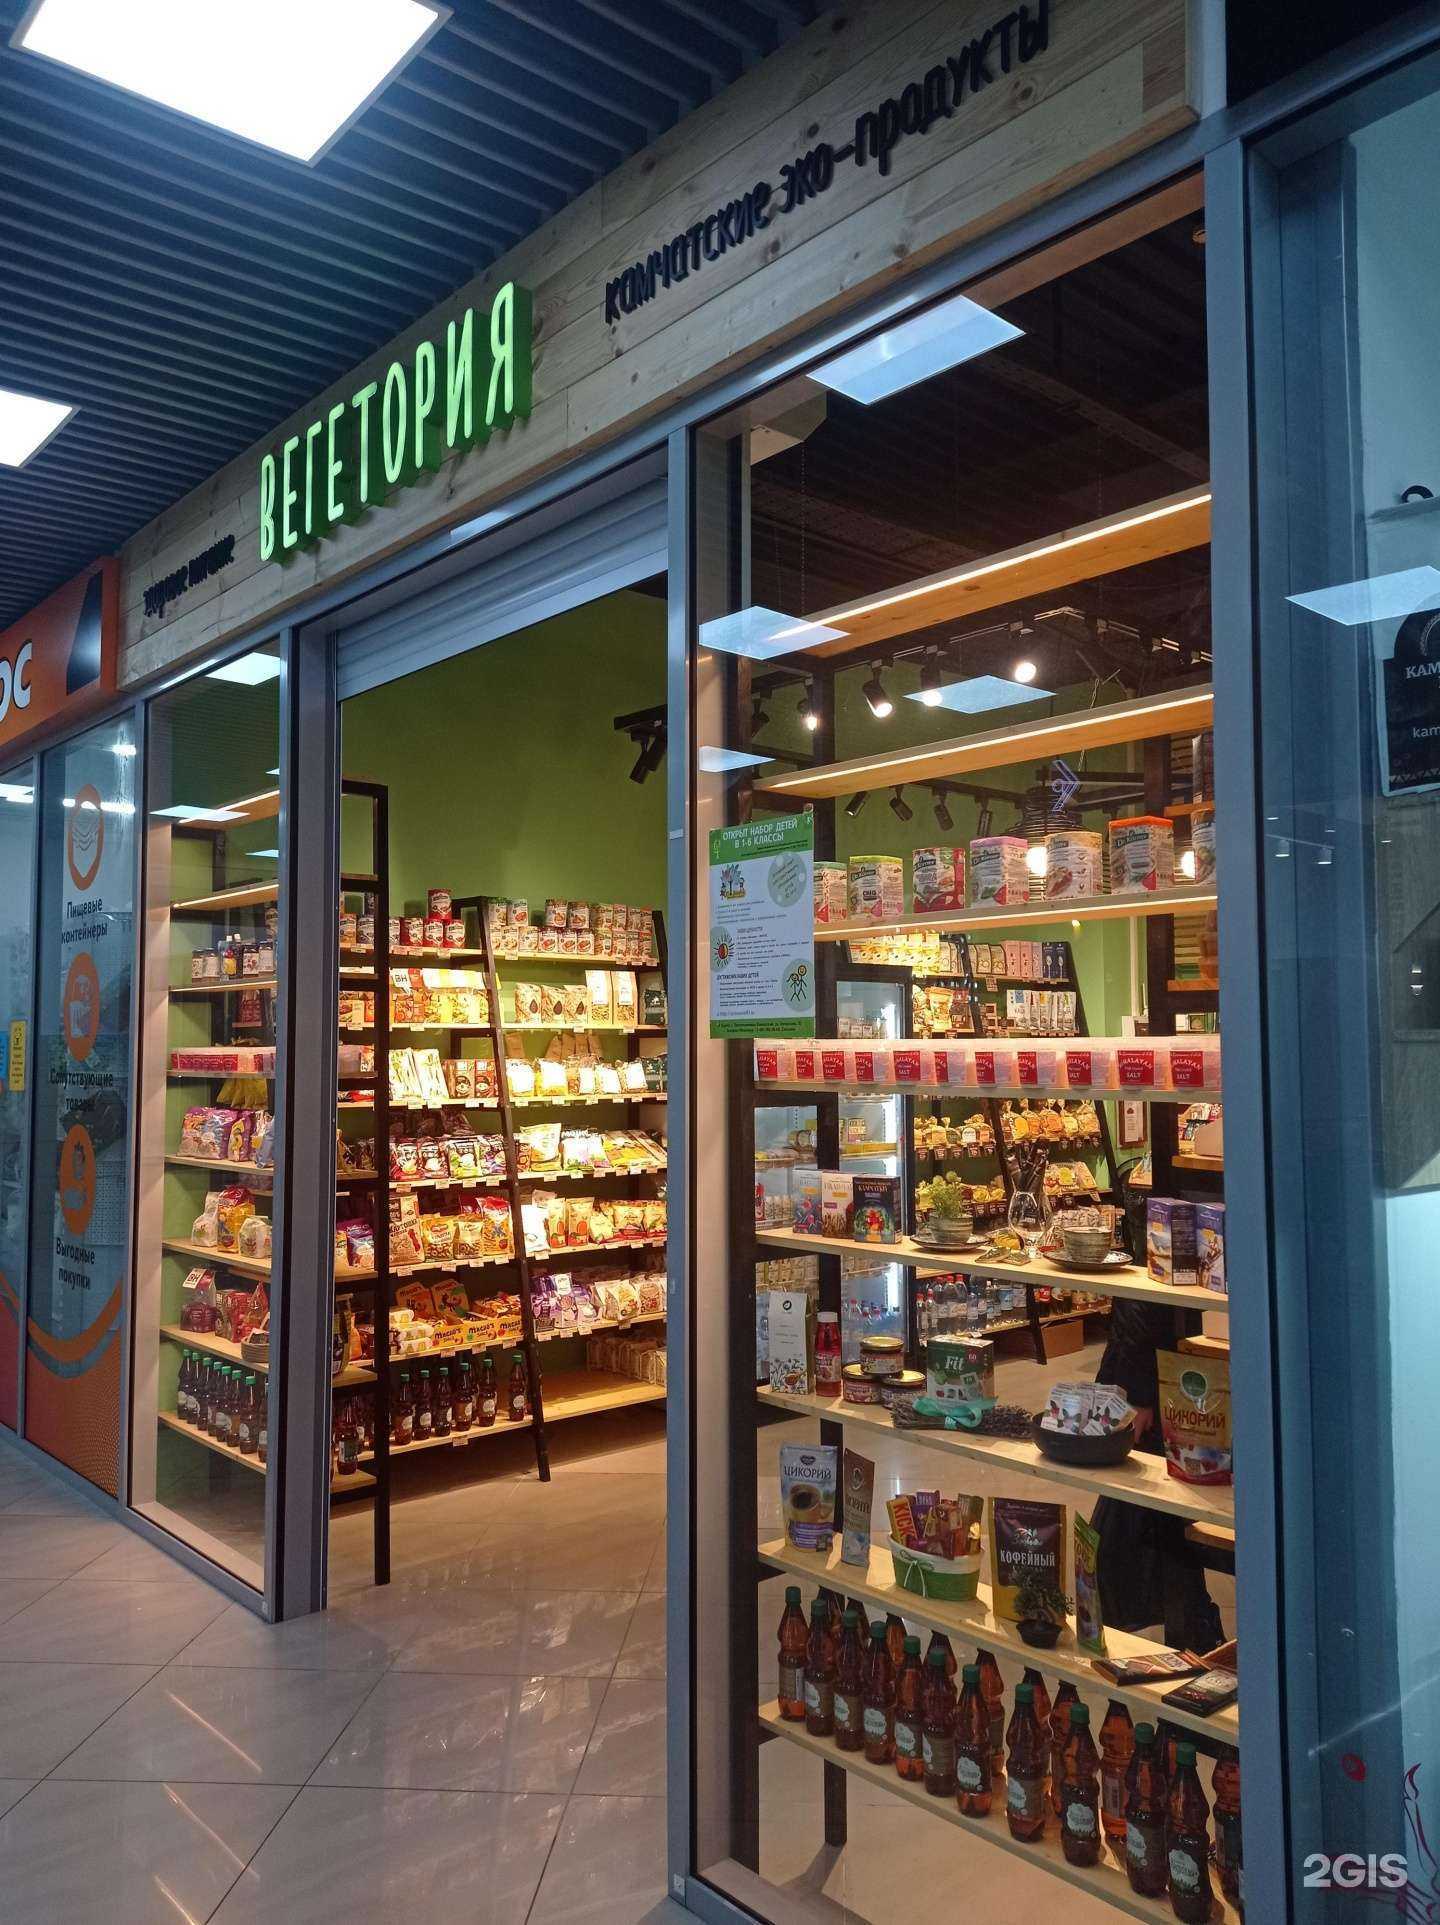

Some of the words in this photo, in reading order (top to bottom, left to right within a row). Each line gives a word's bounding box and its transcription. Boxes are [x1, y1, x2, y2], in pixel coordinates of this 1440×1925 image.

[260, 281, 516, 562] ВЕГЕТОРИЯ
[750, 823, 773, 835] НАБОР
[753, 832, 784, 845] КЛАССЫ
[66, 898, 103, 919] Пищевые
[61, 922, 108, 945] контейнеры
[56, 1237, 96, 1264] Выгодные
[58, 1268, 91, 1290] покупки
[1000, 1549, 1055, 1567] КОФЕЙНЫЙ
